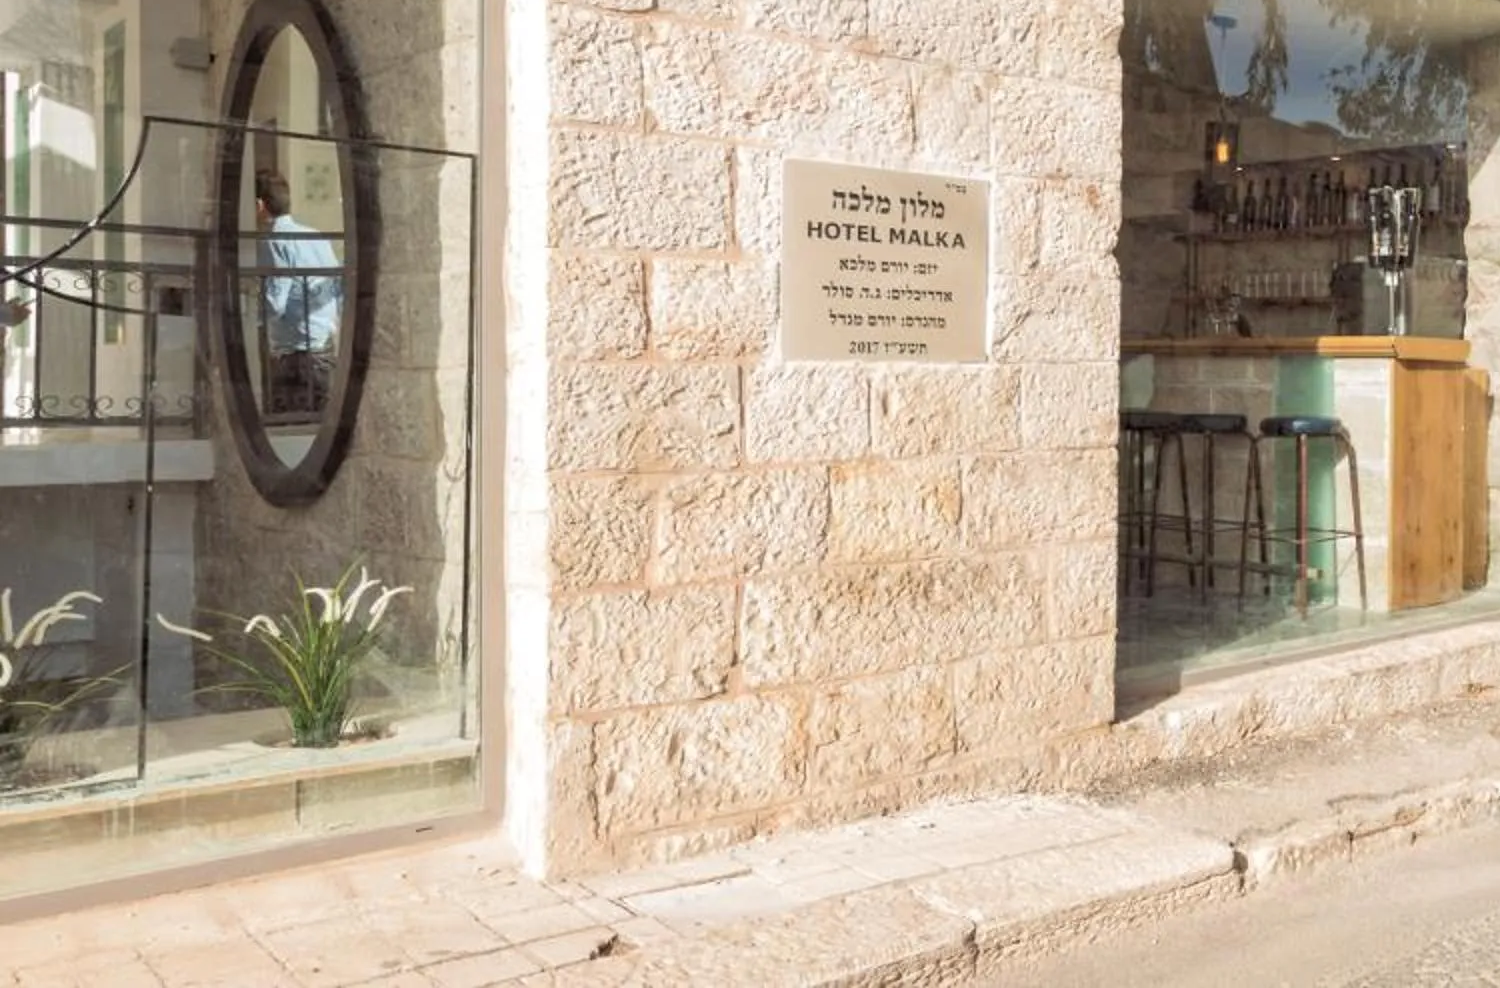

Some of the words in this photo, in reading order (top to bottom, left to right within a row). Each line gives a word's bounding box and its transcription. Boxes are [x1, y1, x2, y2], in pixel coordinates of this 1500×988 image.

[831, 184, 892, 215] מלכה
[899, 191, 946, 224] מלון
[806, 220, 882, 244] HOTEL
[888, 227, 966, 249] MALKA
[838, 253, 877, 272] מלכא
[867, 314, 897, 328] יורם
[848, 340, 880, 355] 2017
